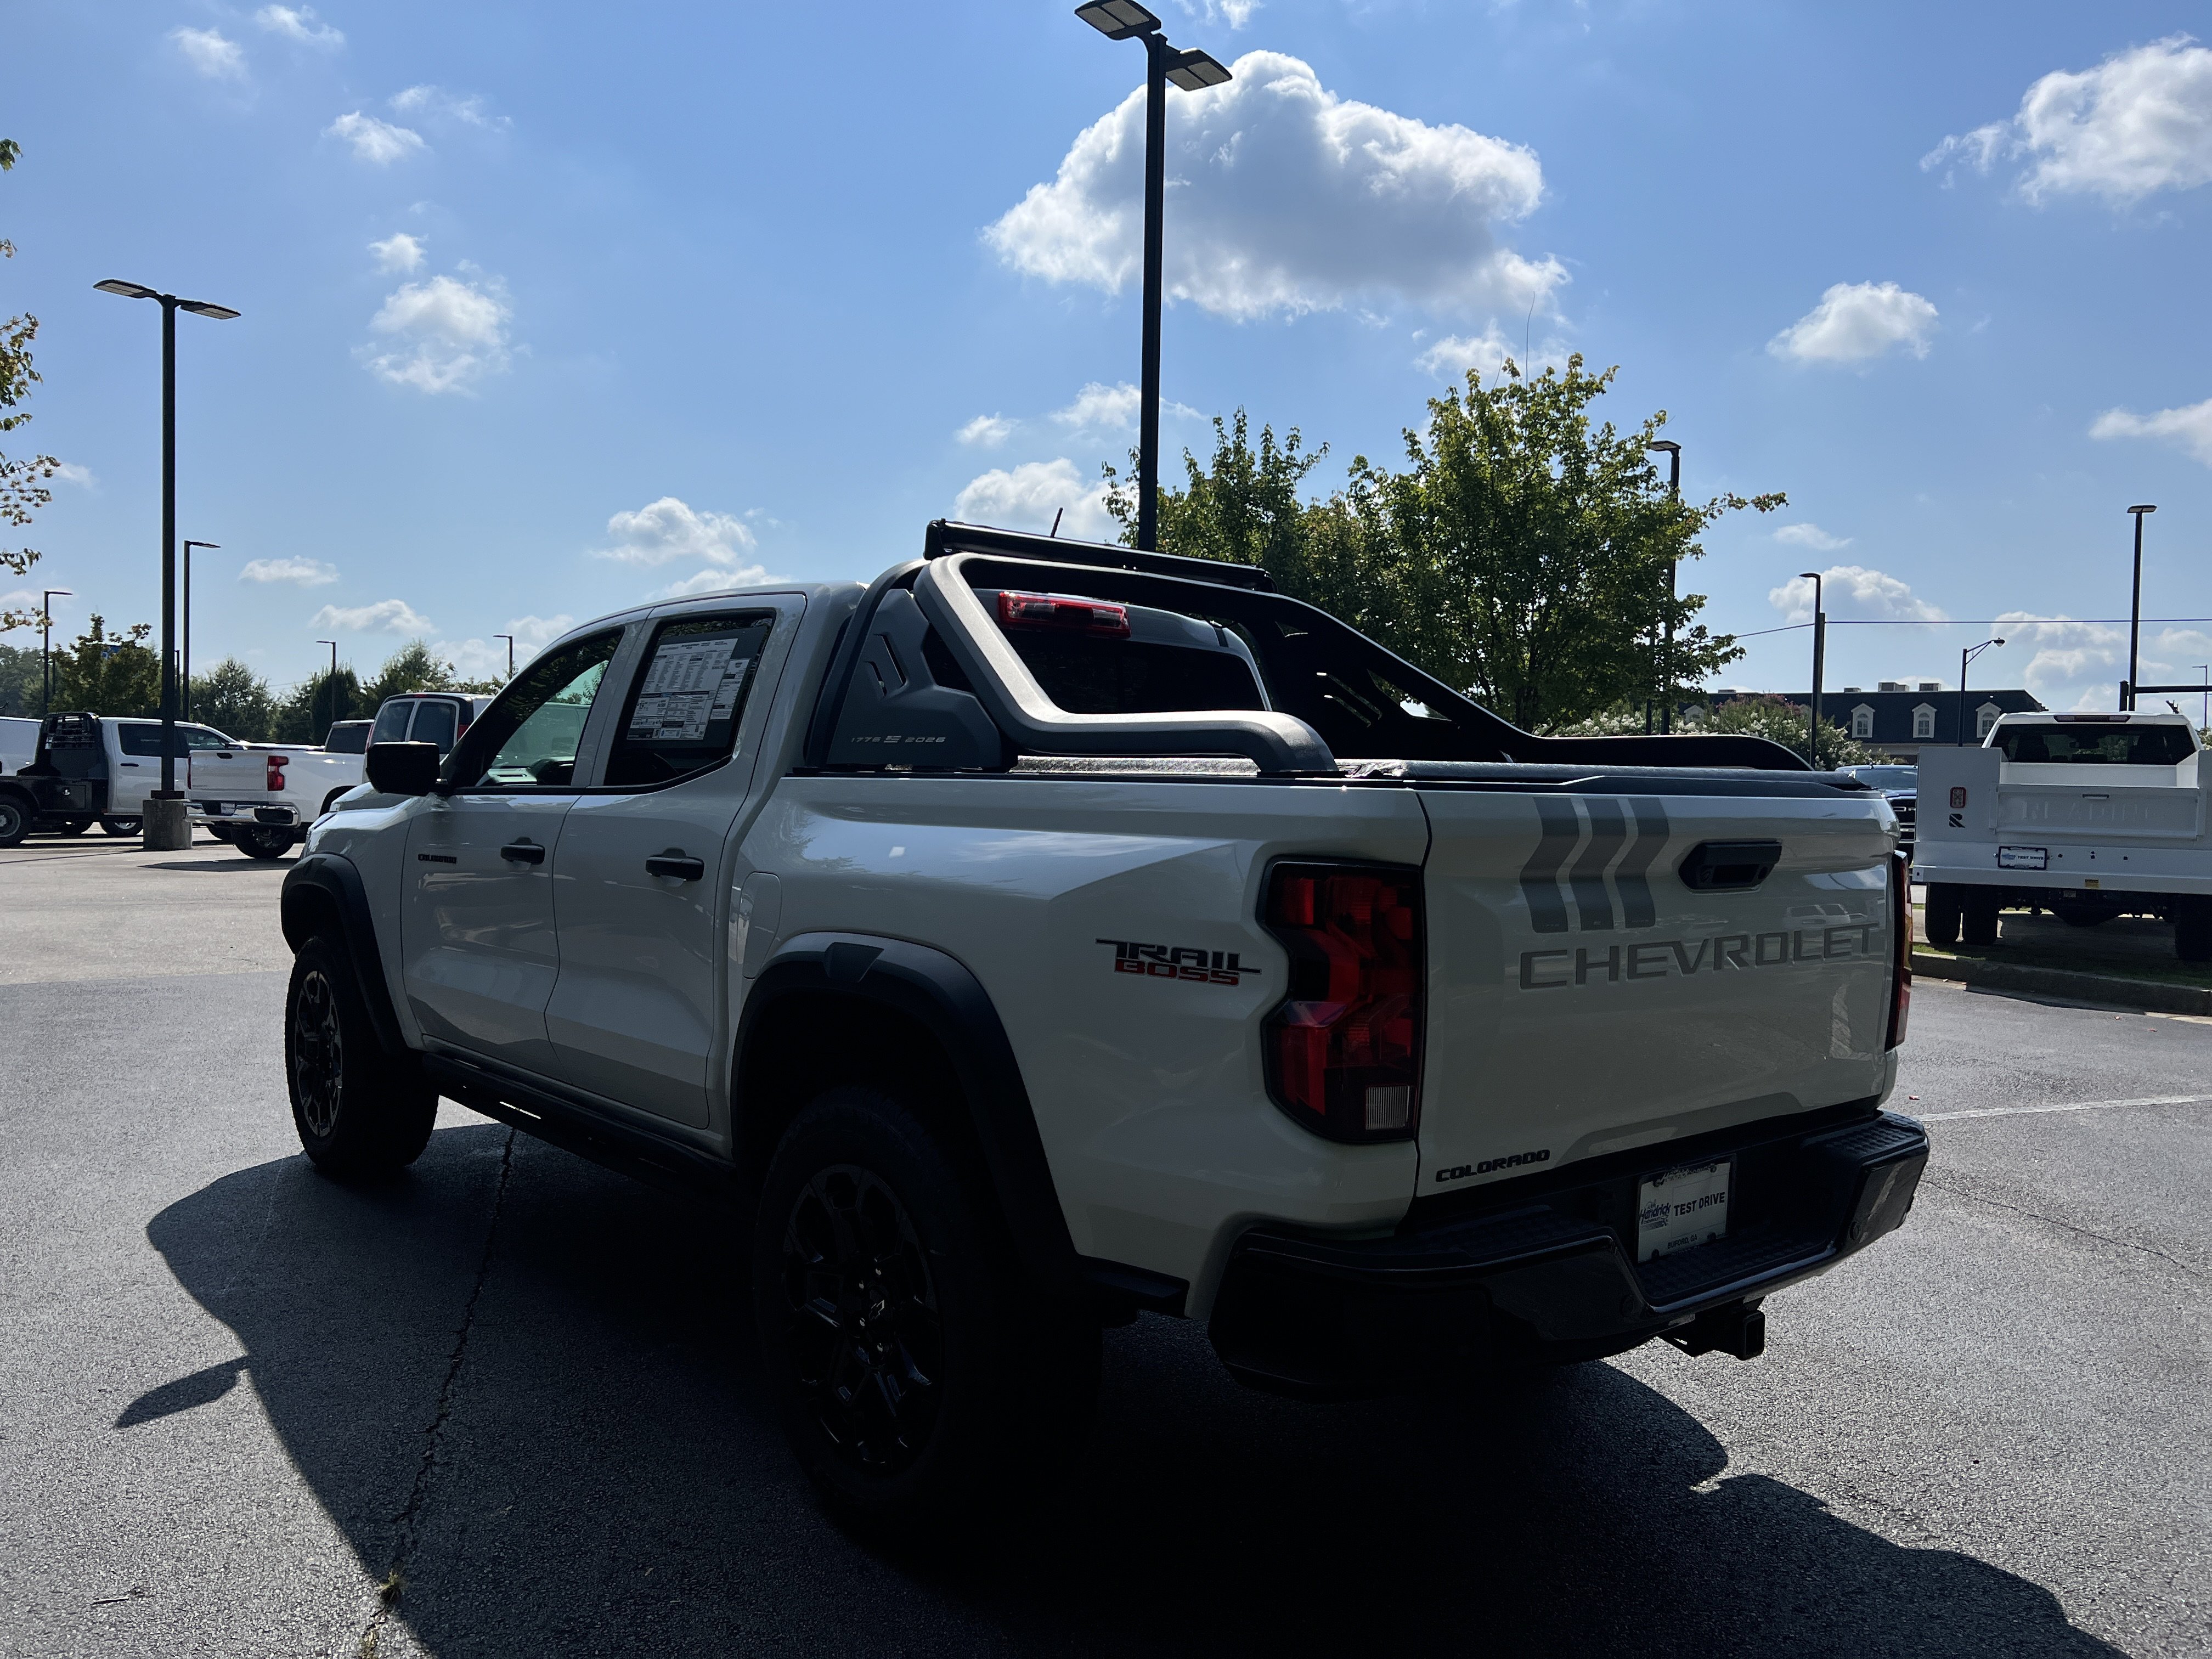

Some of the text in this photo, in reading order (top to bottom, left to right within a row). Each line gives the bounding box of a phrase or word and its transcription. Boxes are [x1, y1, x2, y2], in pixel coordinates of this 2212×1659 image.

[1096, 938, 1261, 974] TRAIL
[1520, 922, 1881, 990] CHEVROLET
[1115, 958, 1240, 986] BOSS
[1435, 1149, 1550, 1182] COLORADO
[1640, 1202, 1672, 1224] Hendrick
[1673, 1192, 1725, 1216] TEST DRIVE
[1667, 1234, 1697, 1249] BUFORD, GA
